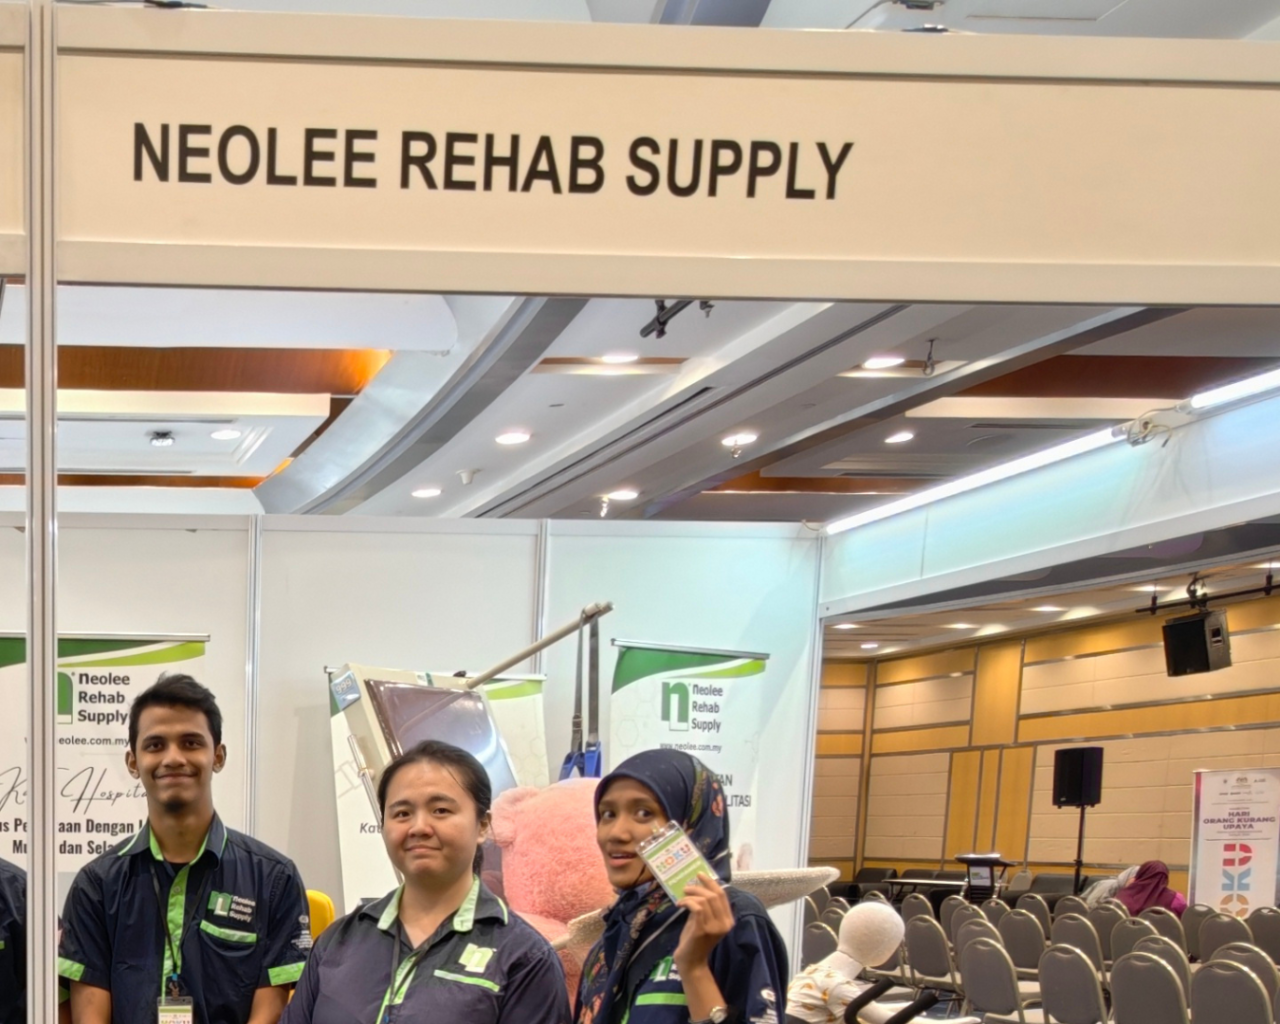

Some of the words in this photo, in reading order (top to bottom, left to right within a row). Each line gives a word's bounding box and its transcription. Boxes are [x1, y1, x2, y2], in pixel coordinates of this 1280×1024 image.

[133, 122, 378, 189] NEOLEE
[400, 130, 605, 195] REHAB
[626, 136, 854, 200] SUPPLY
[78, 672, 130, 685] neolee
[78, 691, 126, 704] Rehab
[692, 684, 724, 697] neolee
[692, 701, 720, 713] Rehab
[78, 710, 128, 725] Supply
[691, 718, 722, 733] Supply
[86, 819, 134, 836] Dengan
[59, 840, 82, 854] dan
